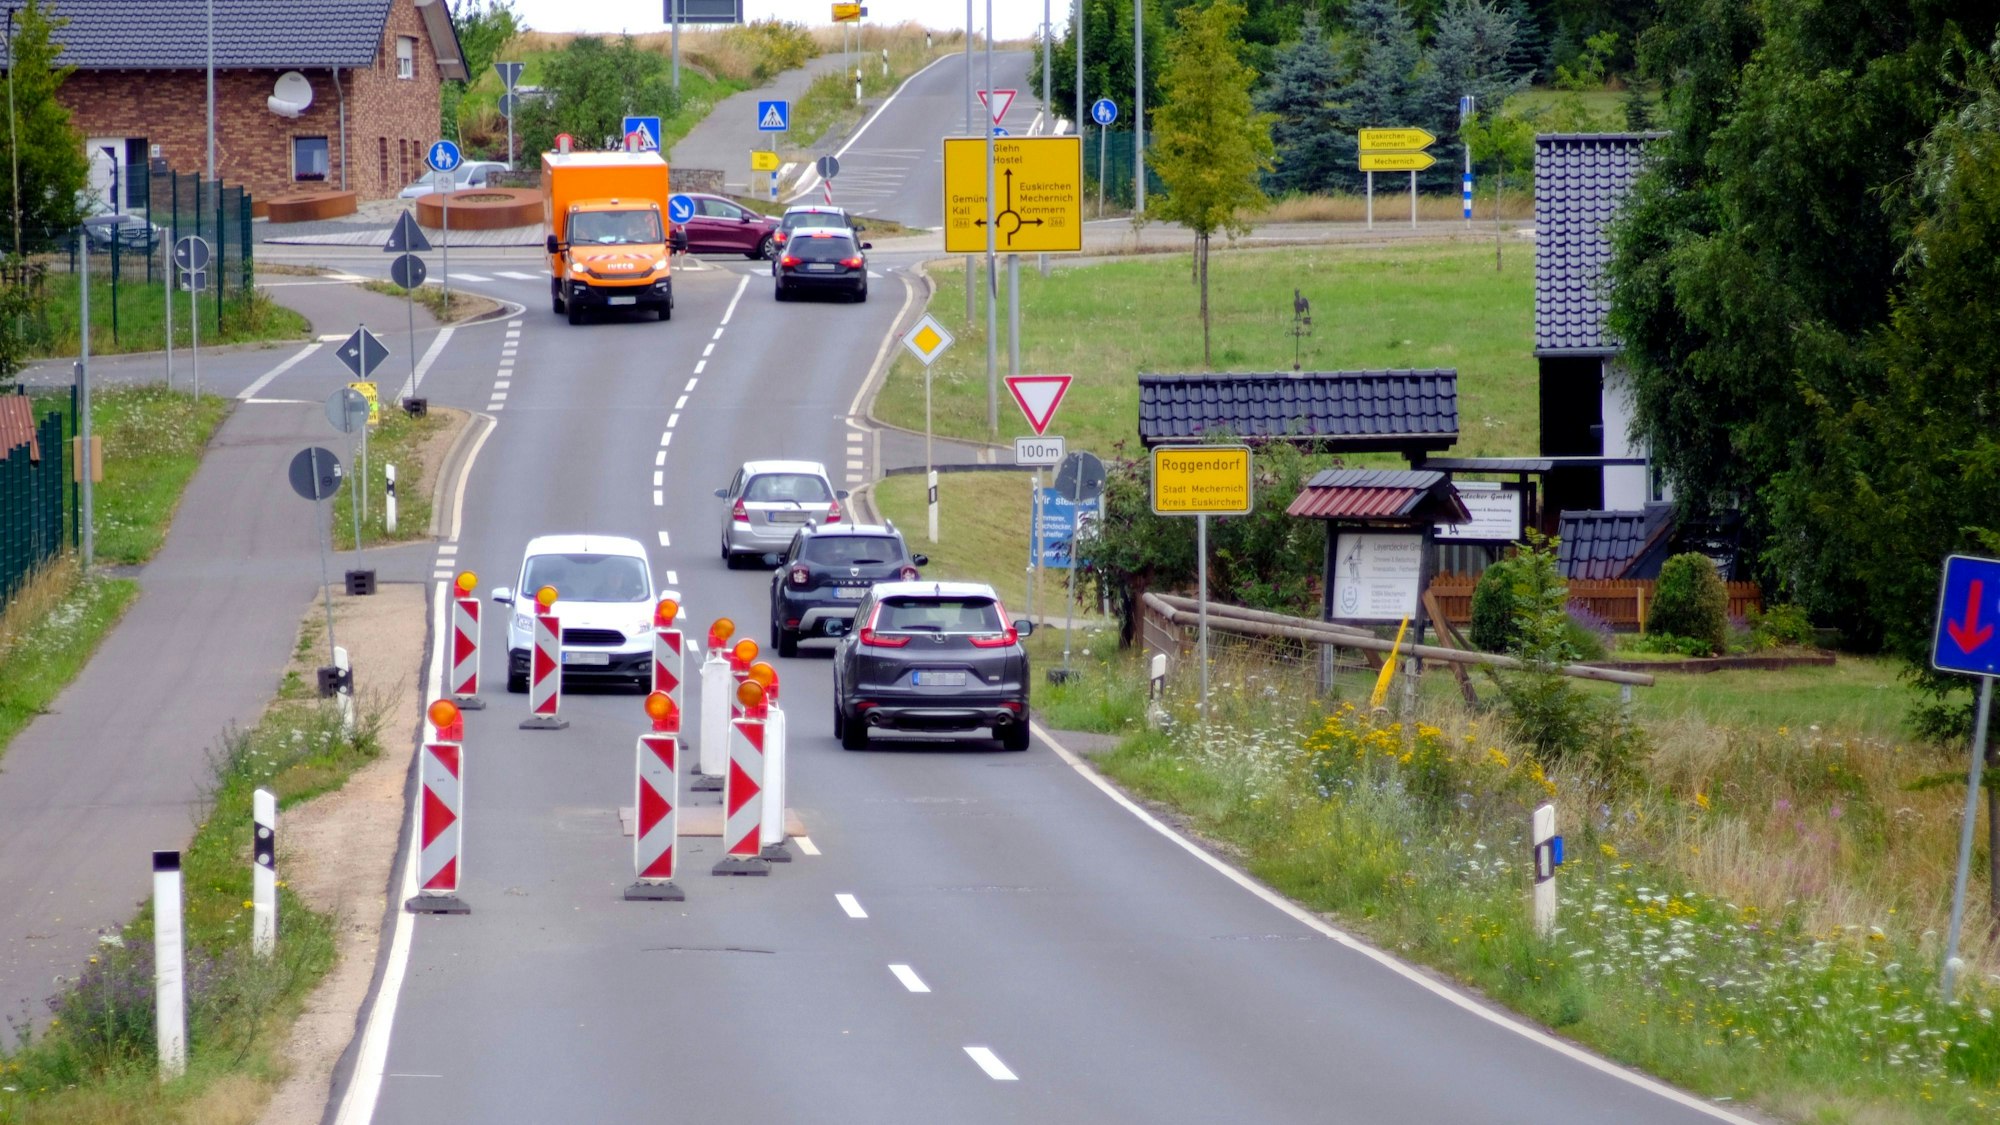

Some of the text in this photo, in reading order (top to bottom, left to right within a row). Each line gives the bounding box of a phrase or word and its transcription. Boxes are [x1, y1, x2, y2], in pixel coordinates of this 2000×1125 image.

[993, 144, 1020, 153] Glehn
[993, 155, 1022, 164] Hostel
[1019, 182, 1071, 191] Euskirchen
[1019, 194, 1073, 203] Mechernich
[952, 207, 970, 215] Kall
[1020, 206, 1066, 214] Kommern
[1162, 458, 1241, 473] Roggendorf
[1163, 484, 1244, 493] Stadt Mechernich
[1162, 498, 1242, 506] Kreis Euskirchen
[1035, 522, 1072, 530] Dchdecker,
